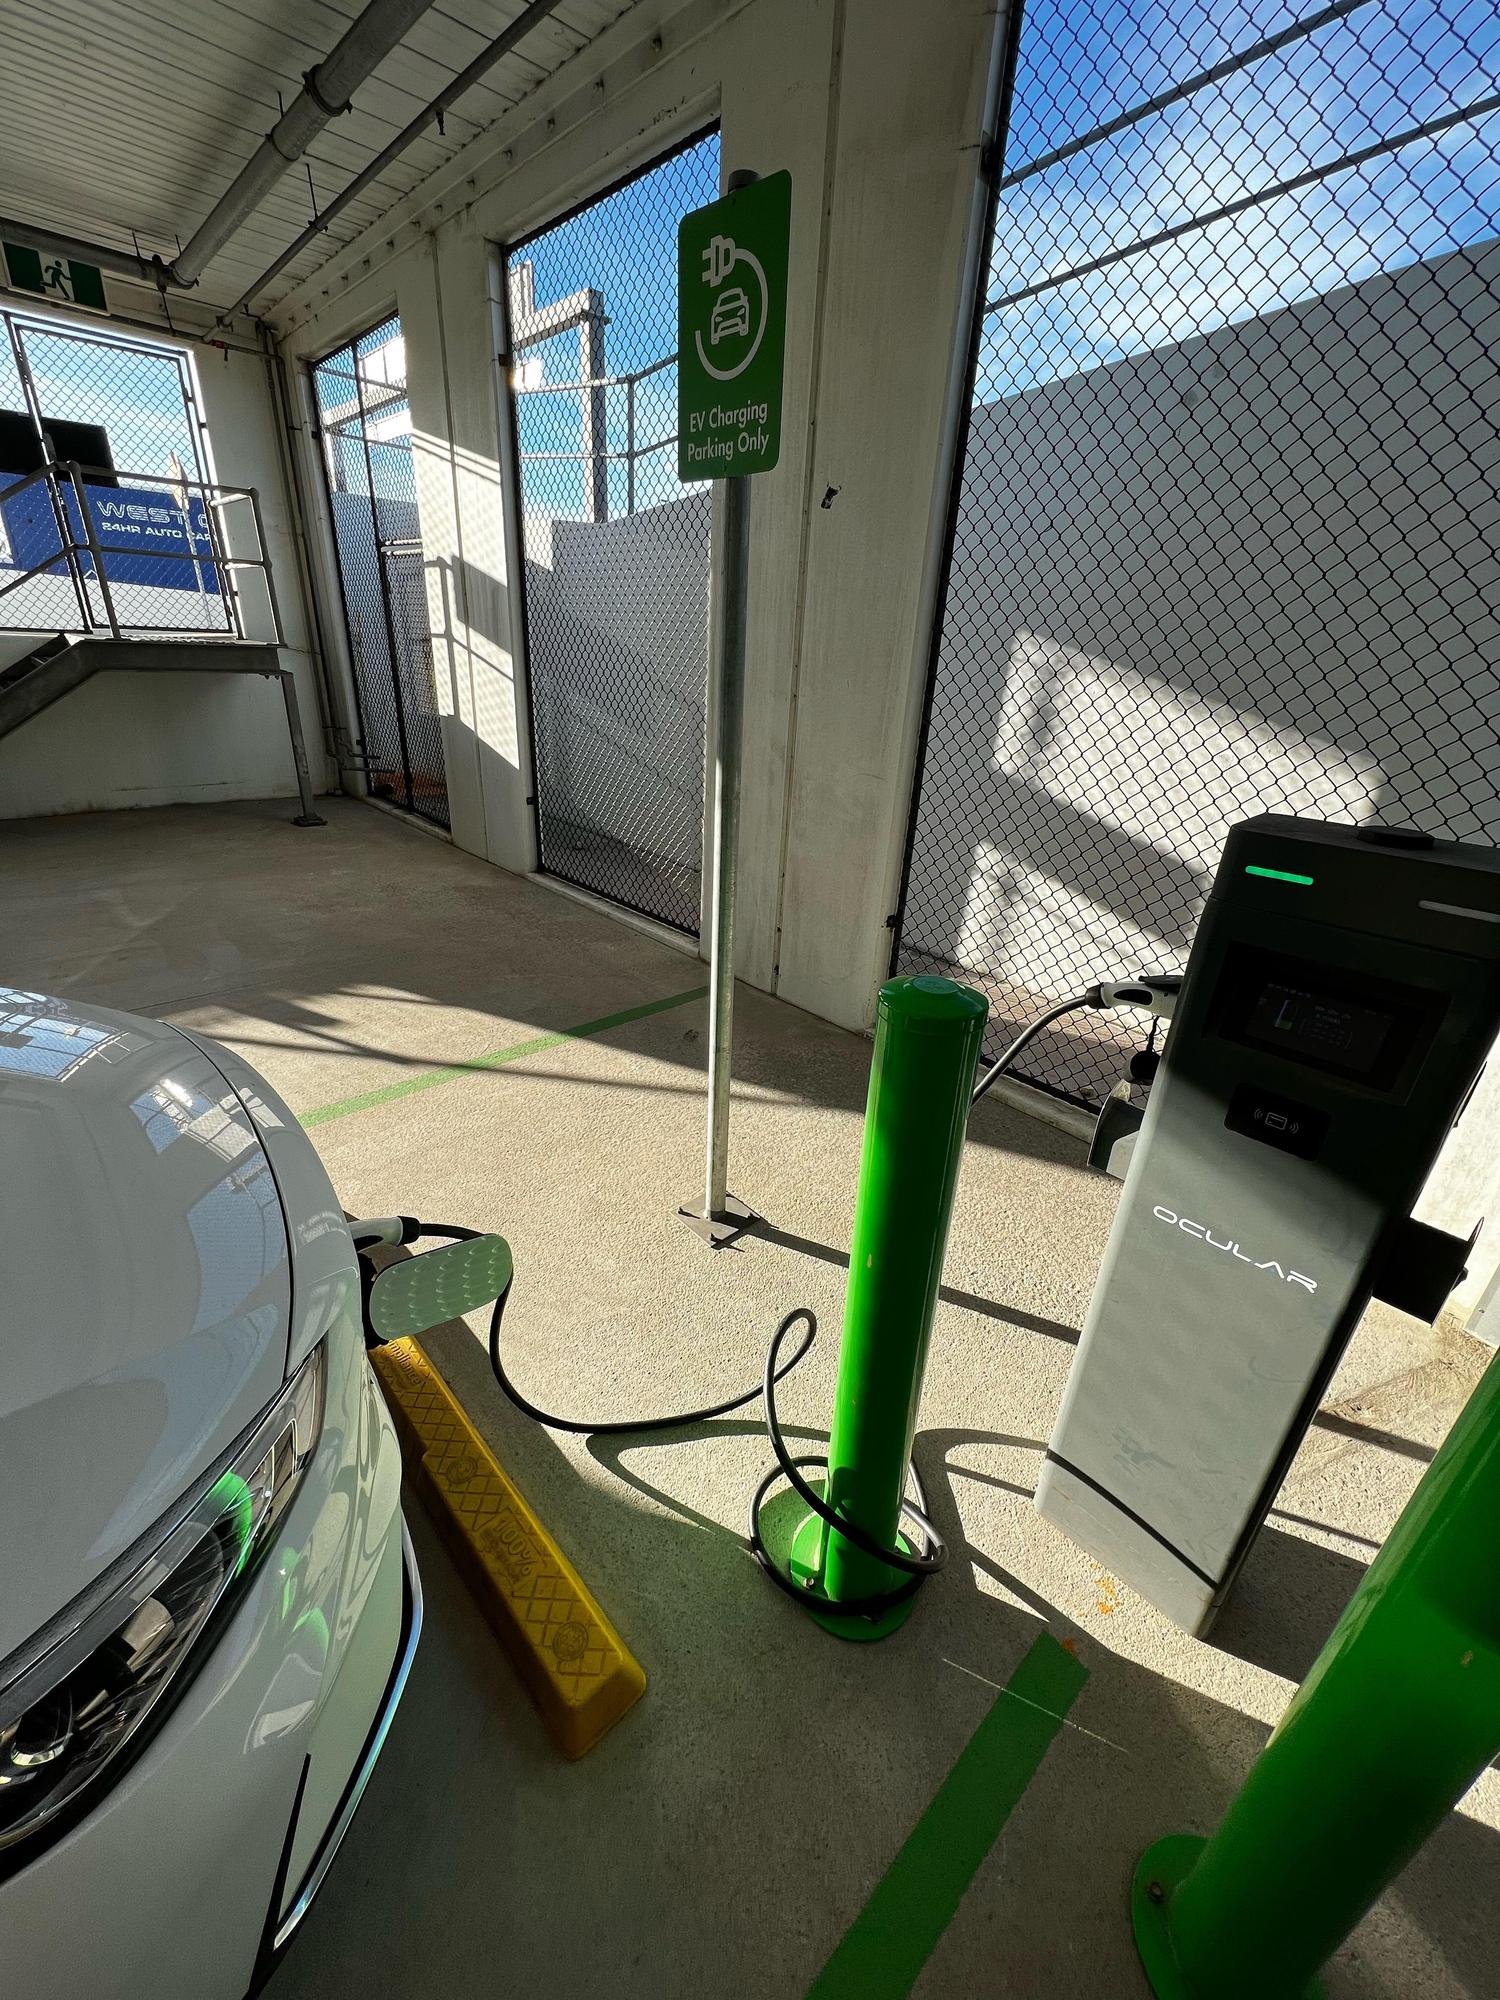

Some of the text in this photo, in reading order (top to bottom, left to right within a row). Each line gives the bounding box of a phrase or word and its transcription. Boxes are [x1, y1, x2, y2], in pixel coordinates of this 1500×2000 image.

[690, 400, 768, 432] EV Charging
[688, 427, 769, 462] Parking Only
[97, 501, 184, 524] WEST
[102, 522, 141, 534] 24HR
[145, 526, 182, 539] AUTO
[1153, 1205, 1318, 1294] OCULAR
[388, 1341, 421, 1385] mpliance
[493, 1519, 538, 1577] 100%
